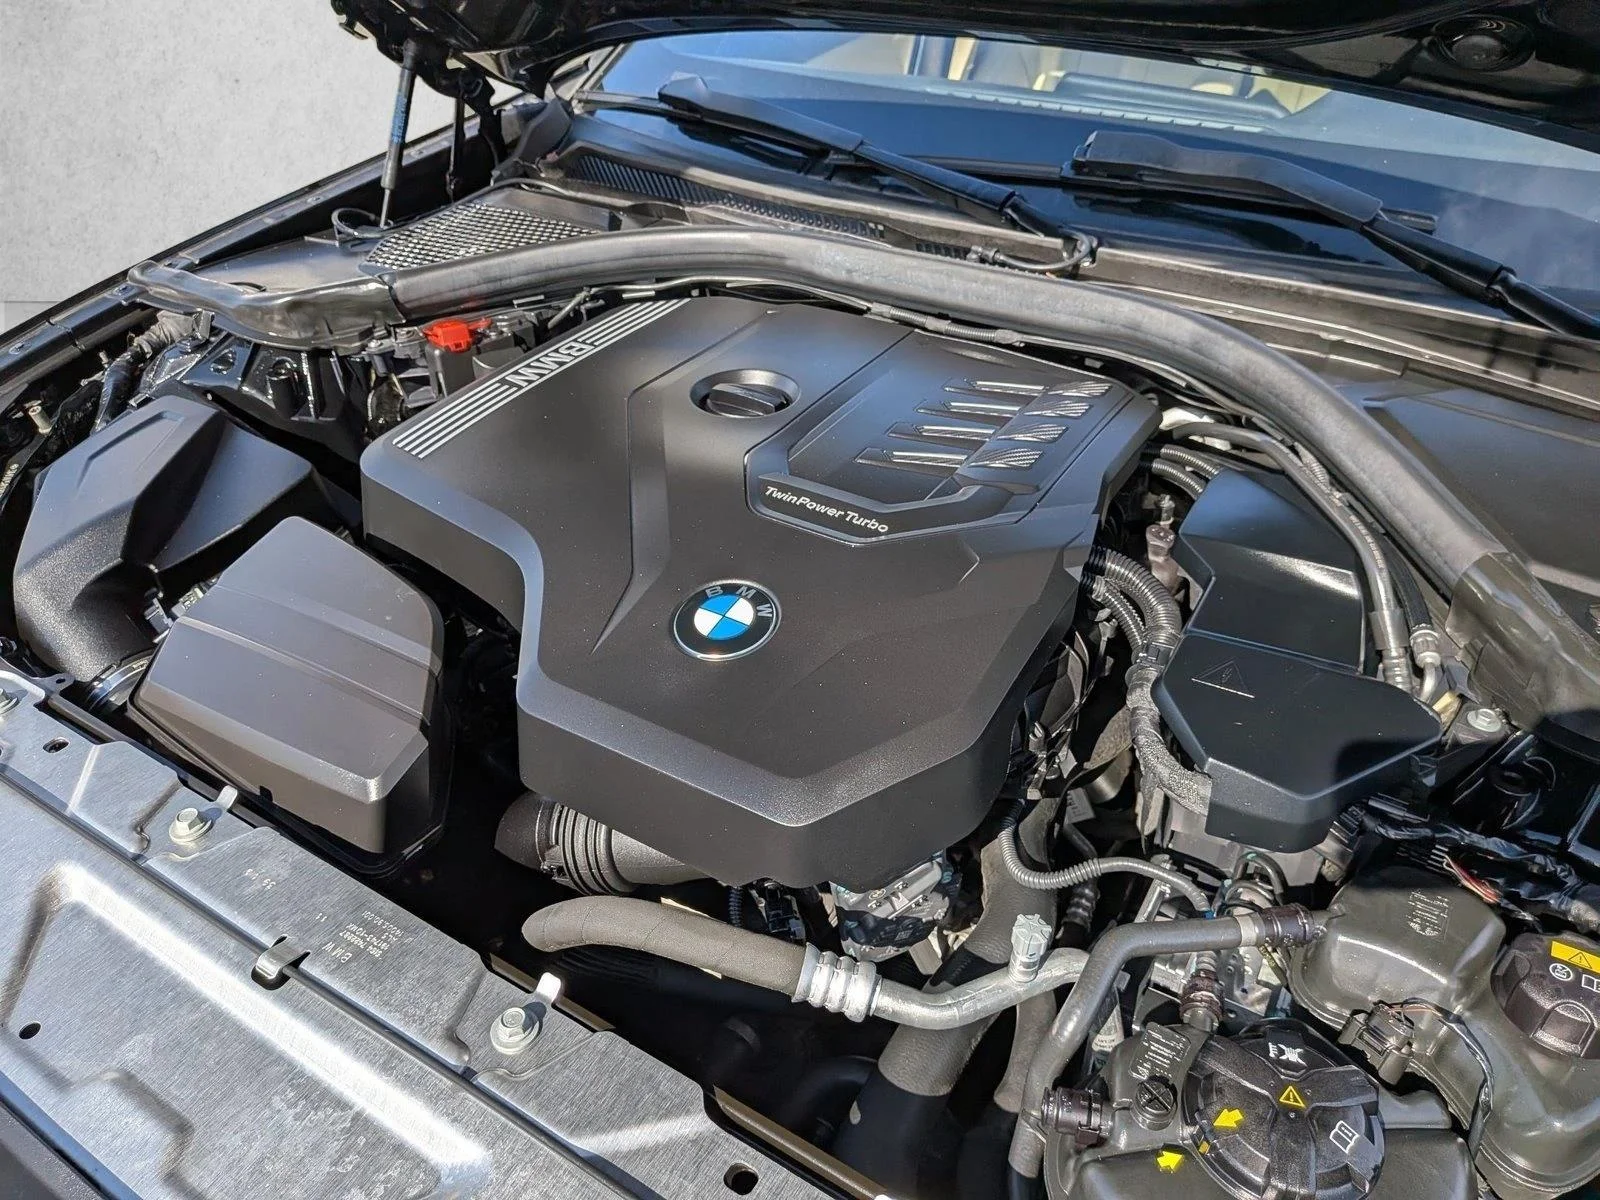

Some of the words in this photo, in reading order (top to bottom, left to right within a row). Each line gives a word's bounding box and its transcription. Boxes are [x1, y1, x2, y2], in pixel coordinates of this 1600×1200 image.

[505, 340, 593, 388] BMW
[765, 486, 844, 518] TwinPower
[844, 511, 889, 533] Turbo
[705, 585, 773, 618] BMW
[321, 941, 352, 963] BMW
